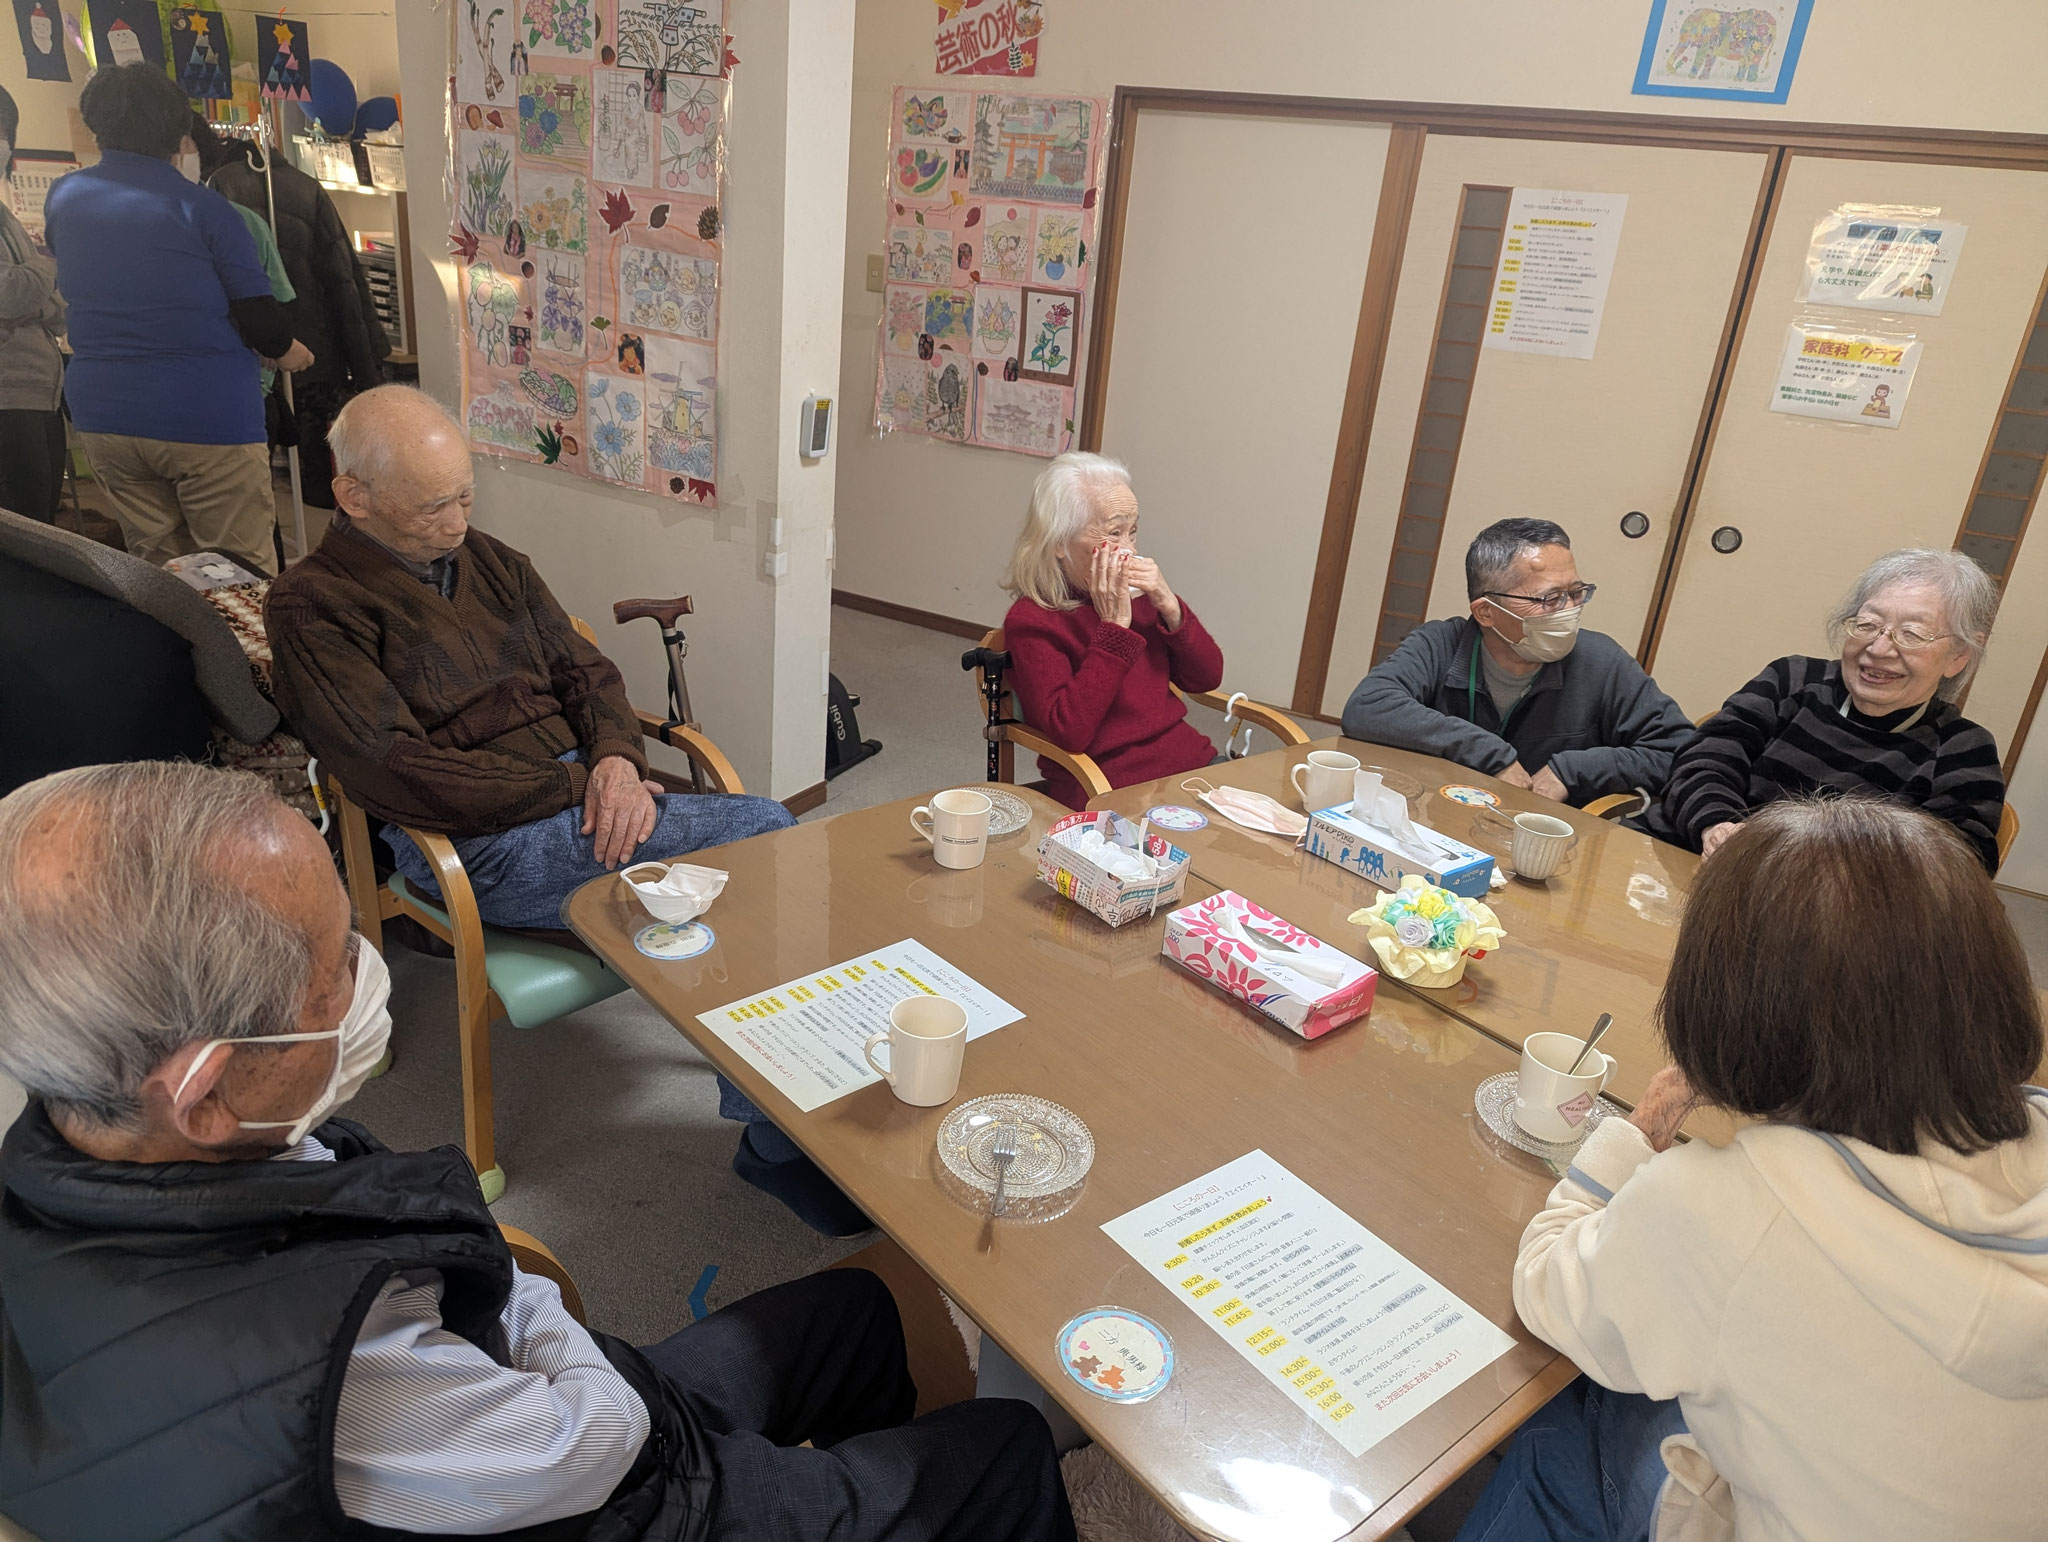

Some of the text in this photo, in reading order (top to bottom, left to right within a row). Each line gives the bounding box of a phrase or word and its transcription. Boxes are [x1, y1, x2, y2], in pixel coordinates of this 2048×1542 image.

[935, 0, 1023, 72] 芸術の秋
[1803, 340, 1850, 357] 家庭科
[1167, 931, 1181, 945] 200
[1171, 1184, 1221, 1211] 【こころの一日】
[1180, 1274, 1205, 1289] 10:20
[1372, 1348, 1462, 1411] また次回元気にお会いしましょう！
[1316, 1391, 1343, 1410] 16:00
[1329, 1402, 1355, 1421] 16:20
